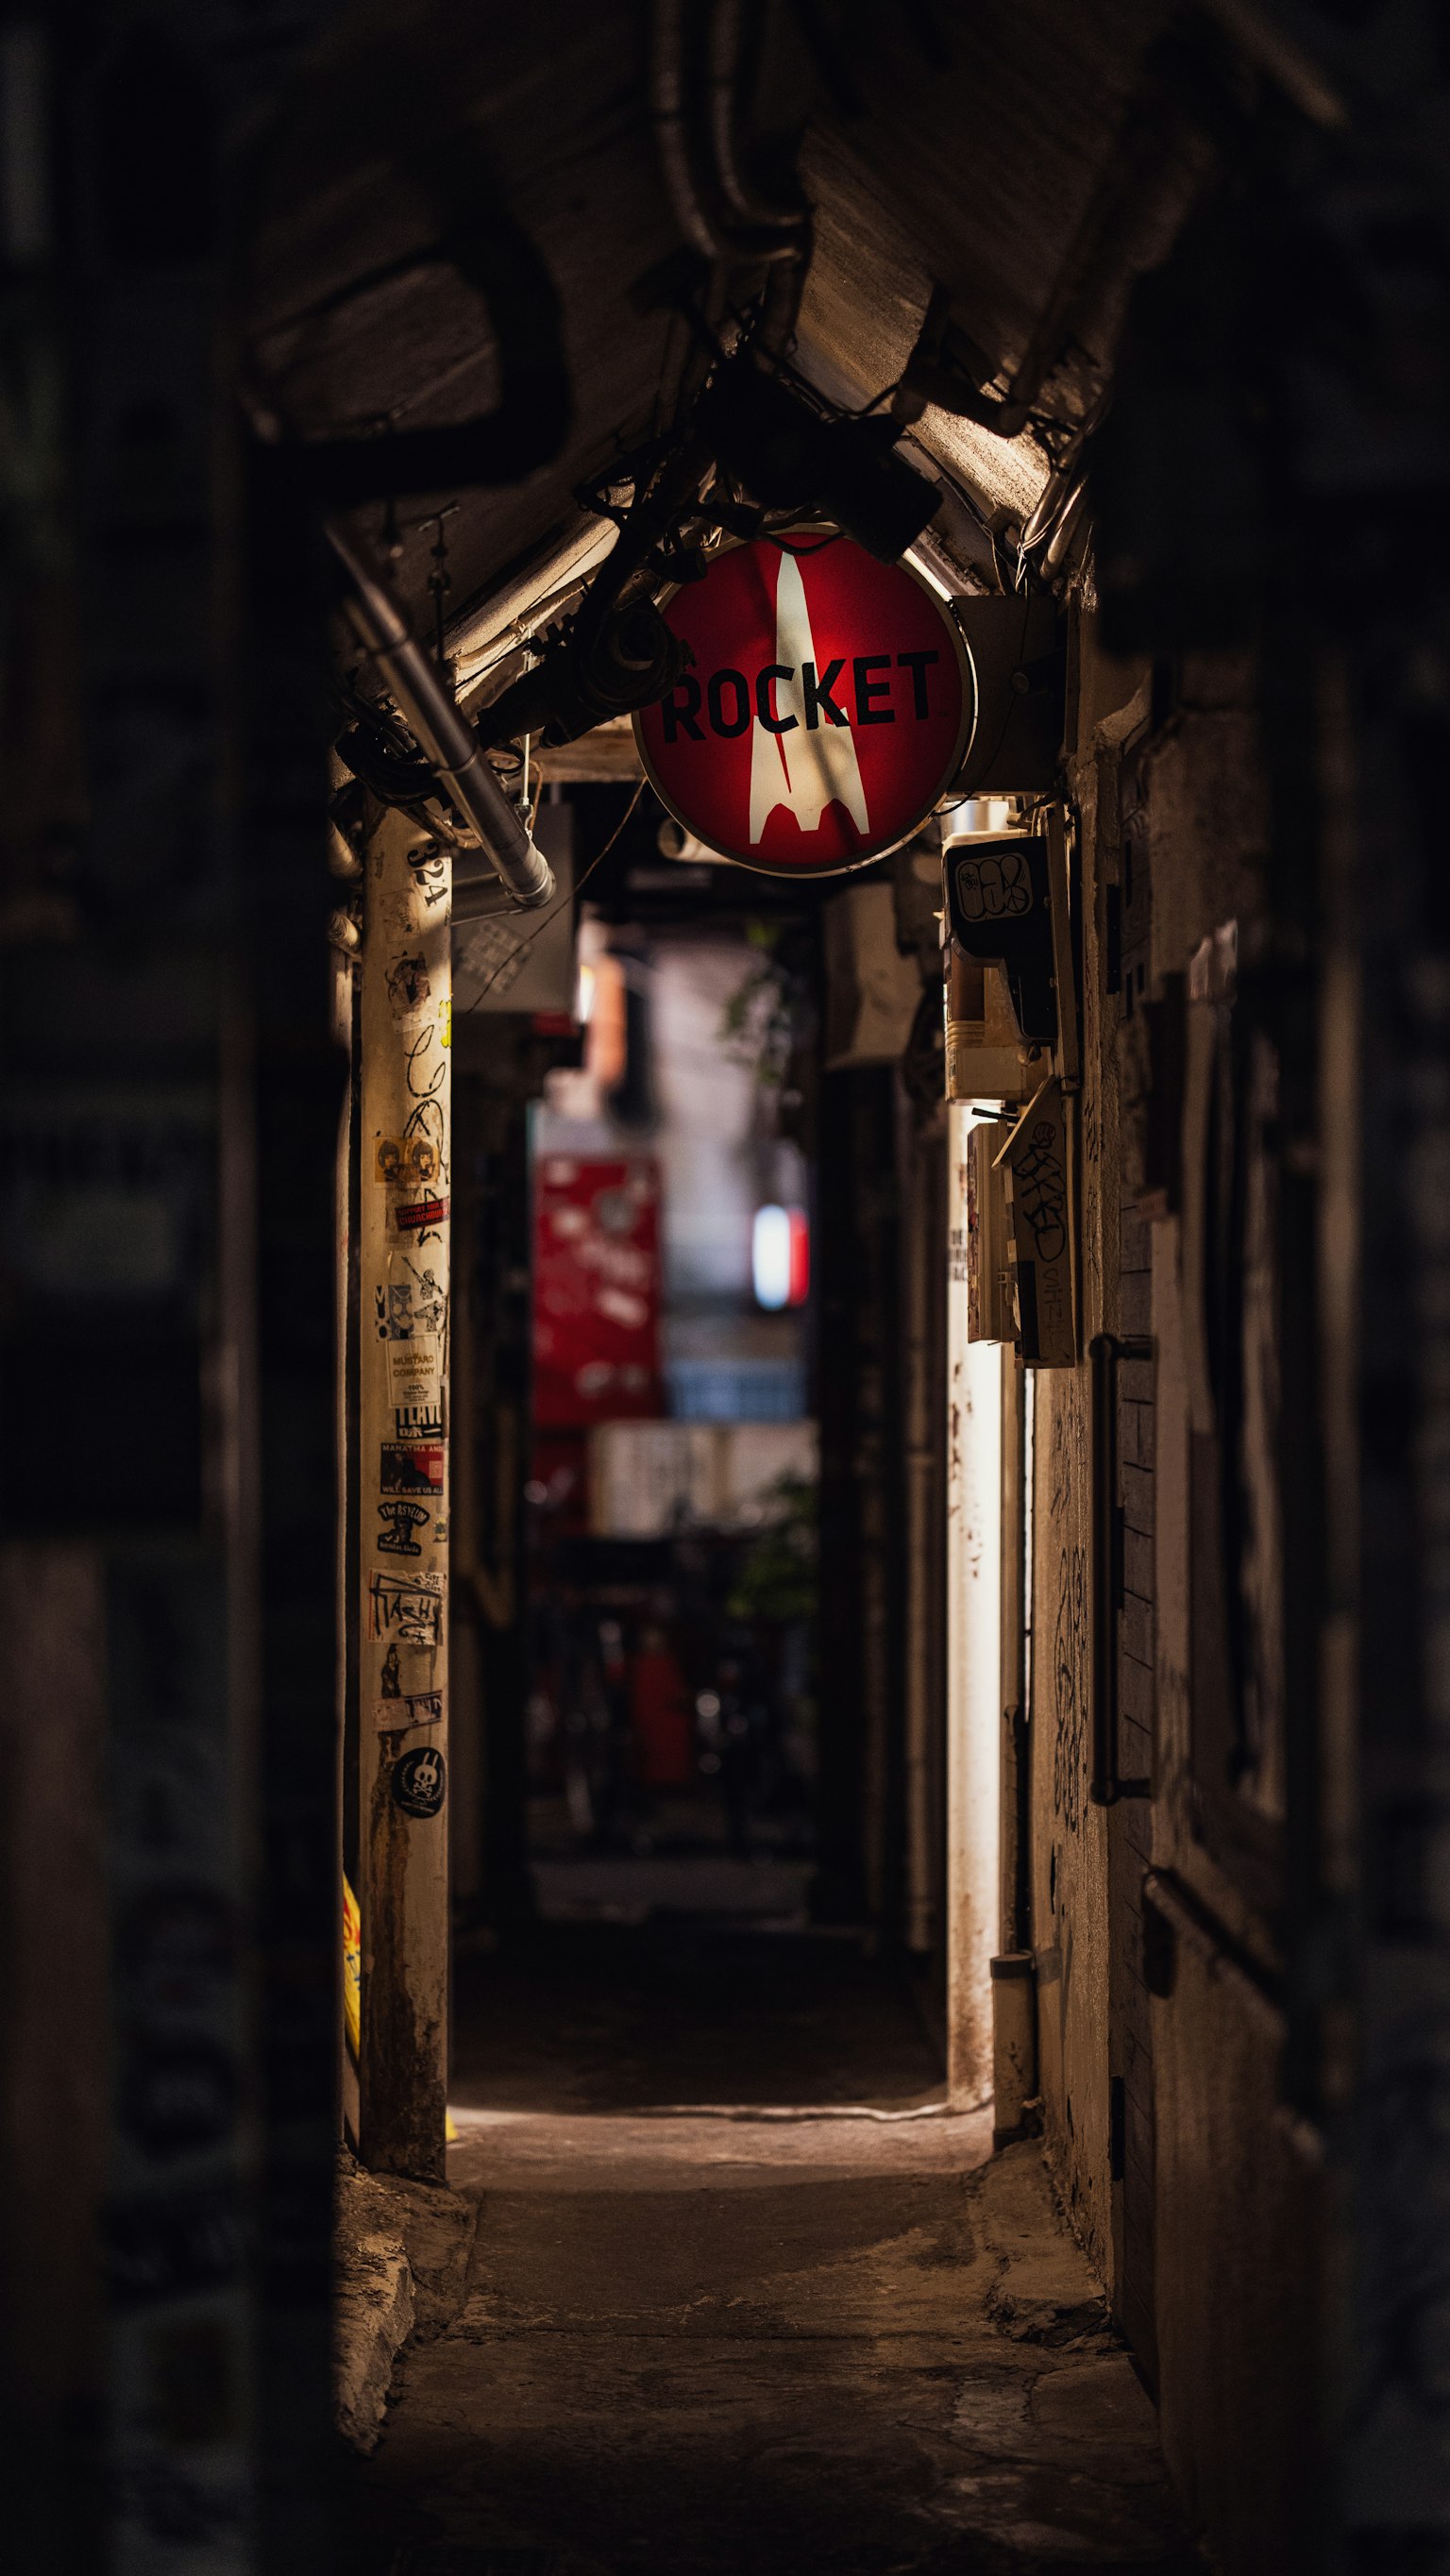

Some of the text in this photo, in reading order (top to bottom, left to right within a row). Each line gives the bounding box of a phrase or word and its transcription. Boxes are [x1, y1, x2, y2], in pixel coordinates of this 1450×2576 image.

[661, 649, 939, 744] ROCKET
[407, 842, 448, 907] 324
[393, 1355, 433, 1366] MUSTARD
[393, 1367, 435, 1377] COMPANY
[379, 1504, 428, 1524] The ASYLUM
